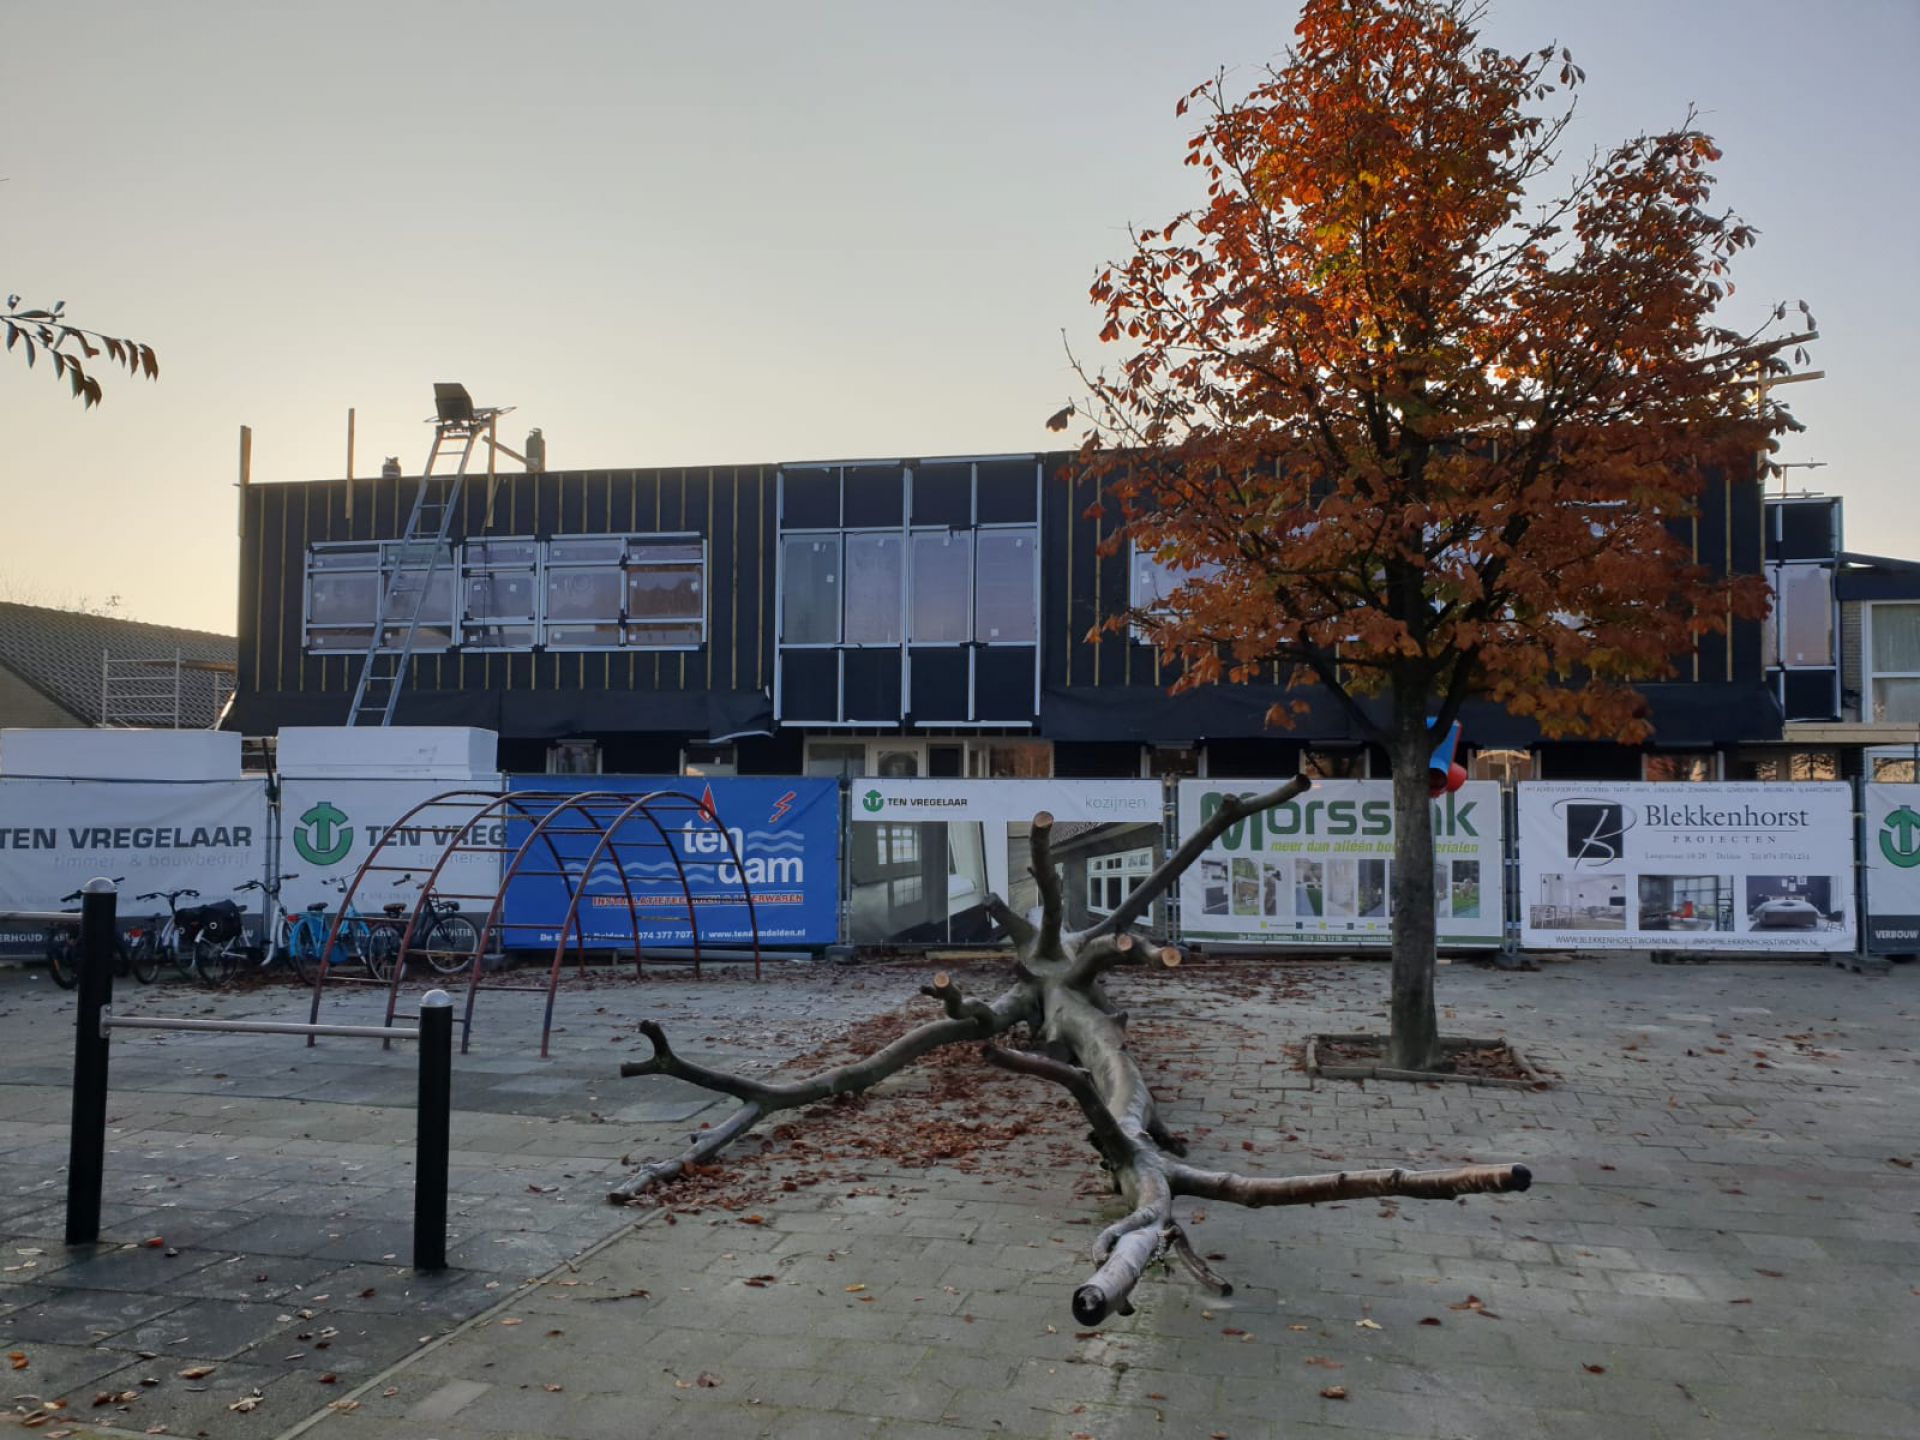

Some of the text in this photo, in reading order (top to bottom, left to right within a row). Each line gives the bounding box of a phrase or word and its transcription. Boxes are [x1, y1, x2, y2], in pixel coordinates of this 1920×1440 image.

[888, 798, 968, 806] TEN VREGELAAR
[1085, 795, 1147, 811] kozijnen
[1200, 792, 1479, 850] Morssk
[1645, 804, 1810, 827] Blekkenhorst
[0, 827, 252, 849] TEN VREGELAAR
[684, 820, 743, 854] ten
[1673, 835, 1777, 844] PROJECTEN
[718, 854, 803, 884] dam
[709, 928, 806, 939] www.tendmdelden.nl
[1875, 930, 1919, 939] VERBOUW
